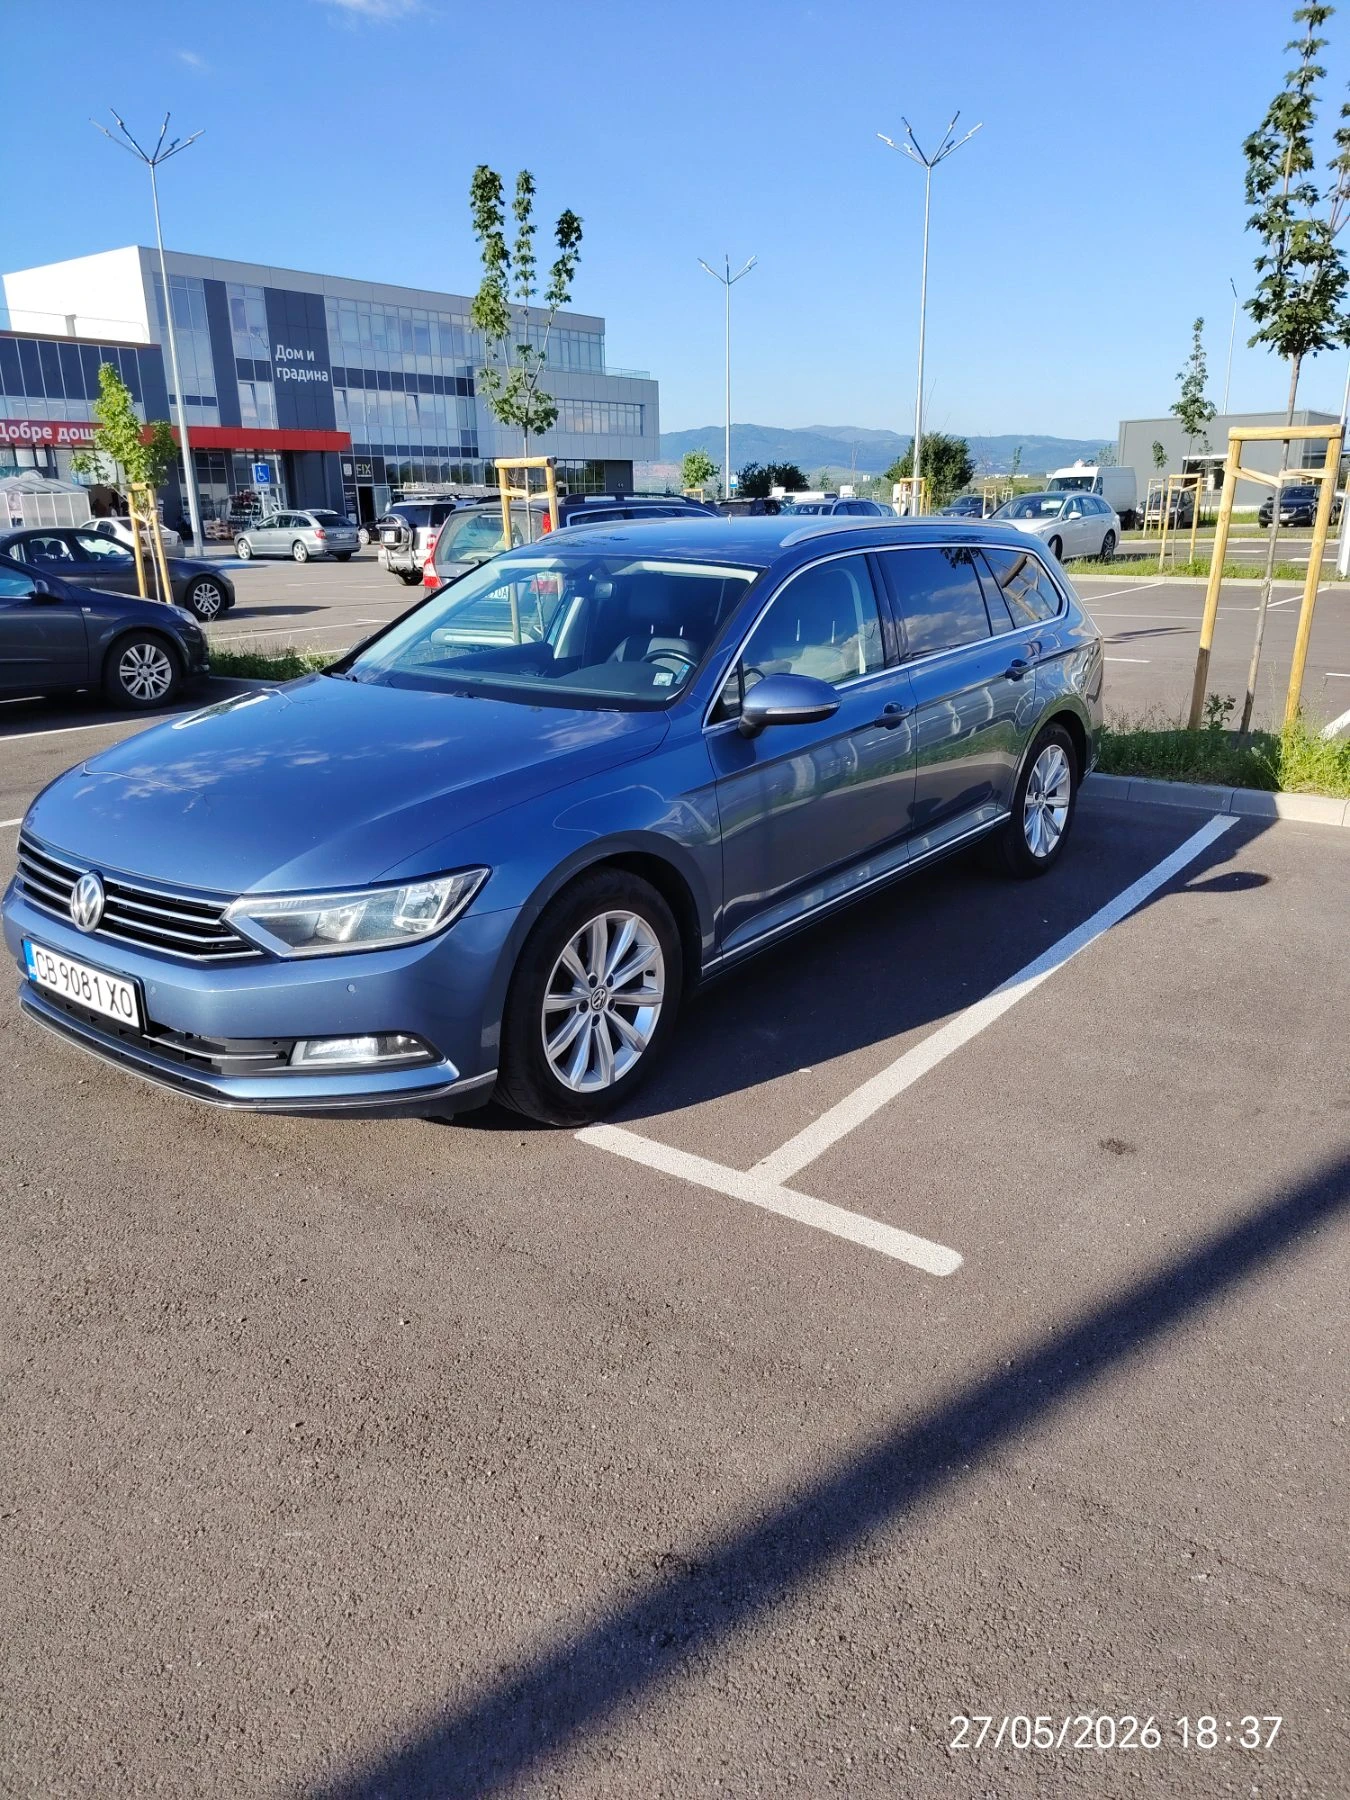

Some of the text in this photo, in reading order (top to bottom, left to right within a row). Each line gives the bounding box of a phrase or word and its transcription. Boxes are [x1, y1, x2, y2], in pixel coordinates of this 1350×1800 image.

[275, 344, 315, 362] Дом и
[276, 367, 329, 382] градина
[0, 421, 97, 443] Добре дош
